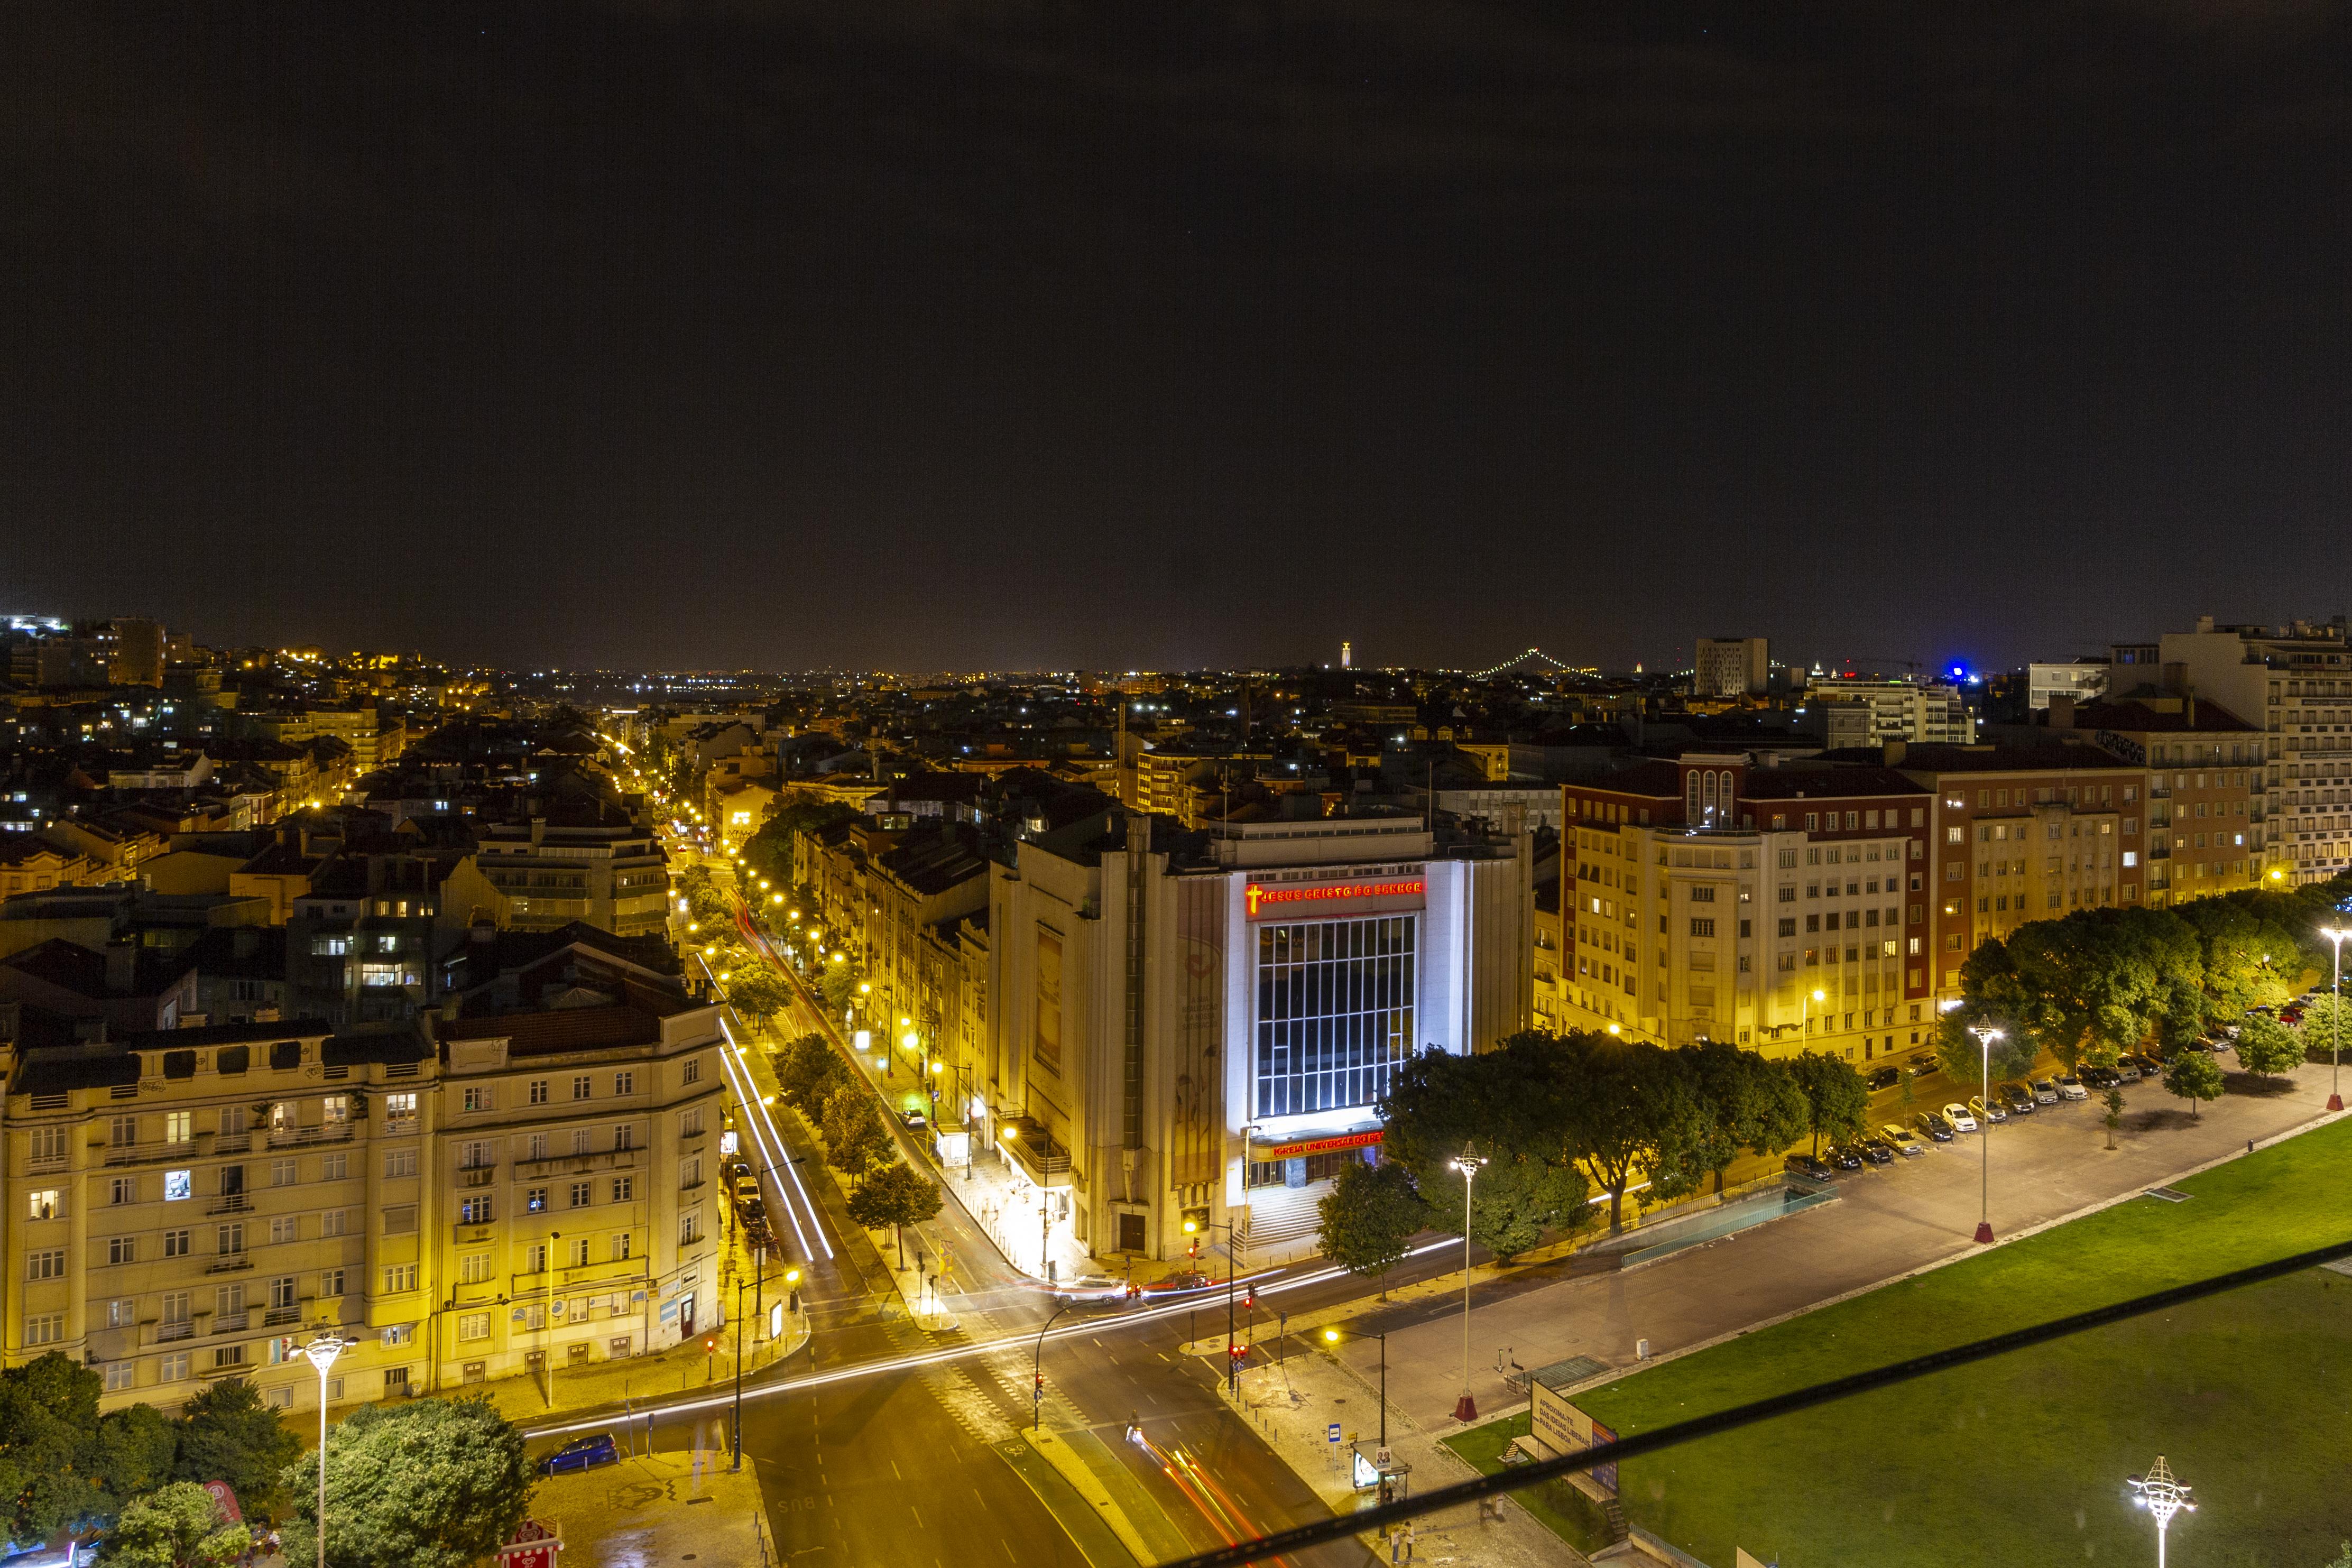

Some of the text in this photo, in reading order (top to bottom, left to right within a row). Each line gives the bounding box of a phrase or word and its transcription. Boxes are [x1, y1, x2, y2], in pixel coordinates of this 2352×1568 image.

[1261, 882, 1423, 902] JESUS CRISTO É O SENHOR
[1274, 1144, 1303, 1156] IGREJA
[1306, 1137, 1354, 1151] UNIVERSAL
[1354, 1134, 1368, 1144] DO
[1539, 1398, 1574, 1427] APROXIMA-TE
[1539, 1407, 1549, 1421] DAS
[1550, 1415, 1566, 1432] IDEIAS
[1567, 1424, 1591, 1448] LIBERAIS
[1539, 1417, 1571, 1445] PARA LISBOA
